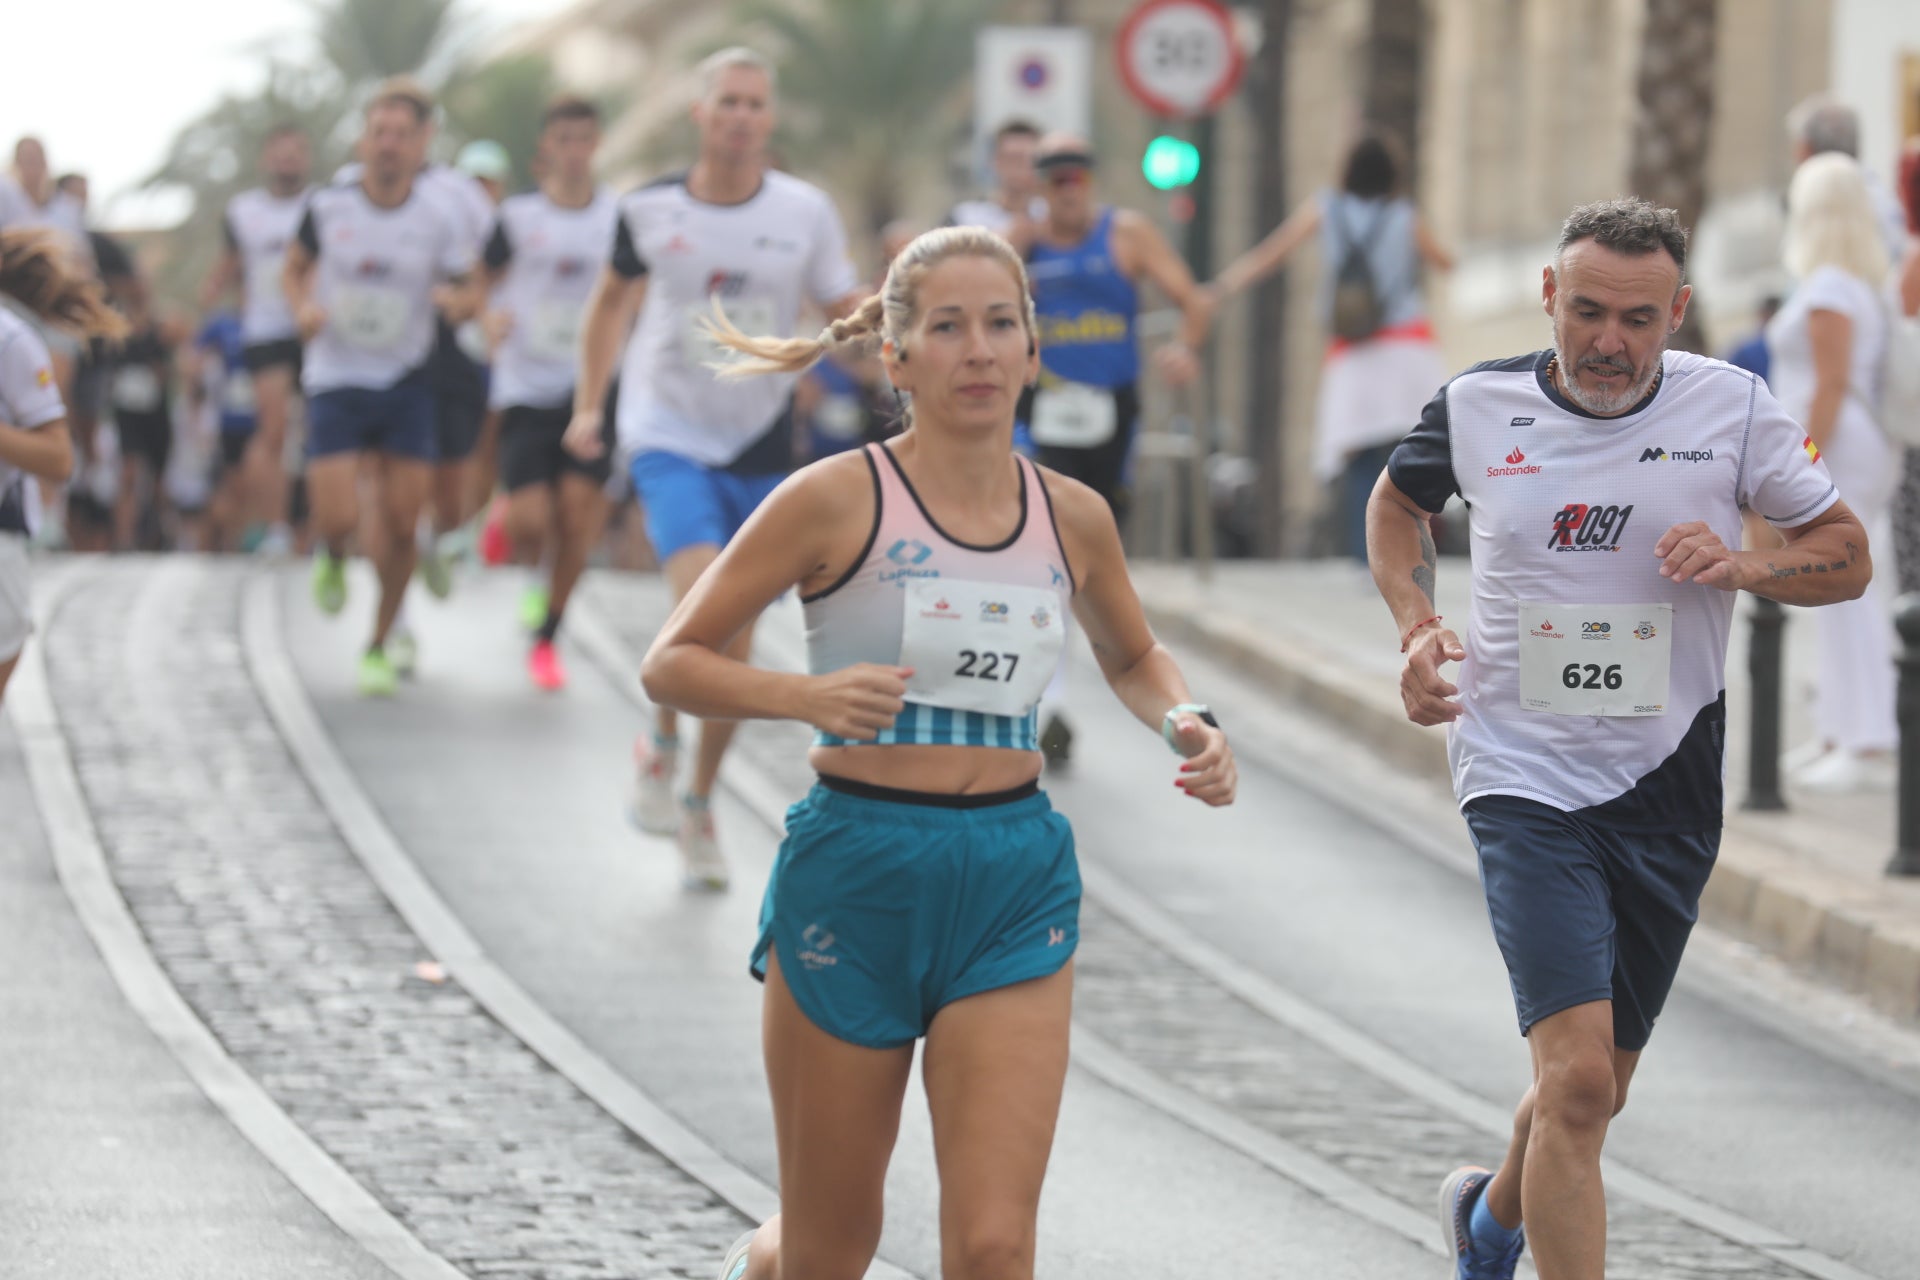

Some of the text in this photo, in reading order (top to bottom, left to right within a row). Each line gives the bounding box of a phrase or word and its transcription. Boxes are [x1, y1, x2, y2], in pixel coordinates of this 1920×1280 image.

[1671, 448, 1714, 464] mupol
[1486, 464, 1543, 477] Santander
[1555, 545, 1616, 553] SOLIDARIA
[1581, 621, 1611, 633] 200
[1530, 629, 1565, 640] Santander
[953, 648, 1020, 683] 227
[1562, 662, 1623, 690] 626
